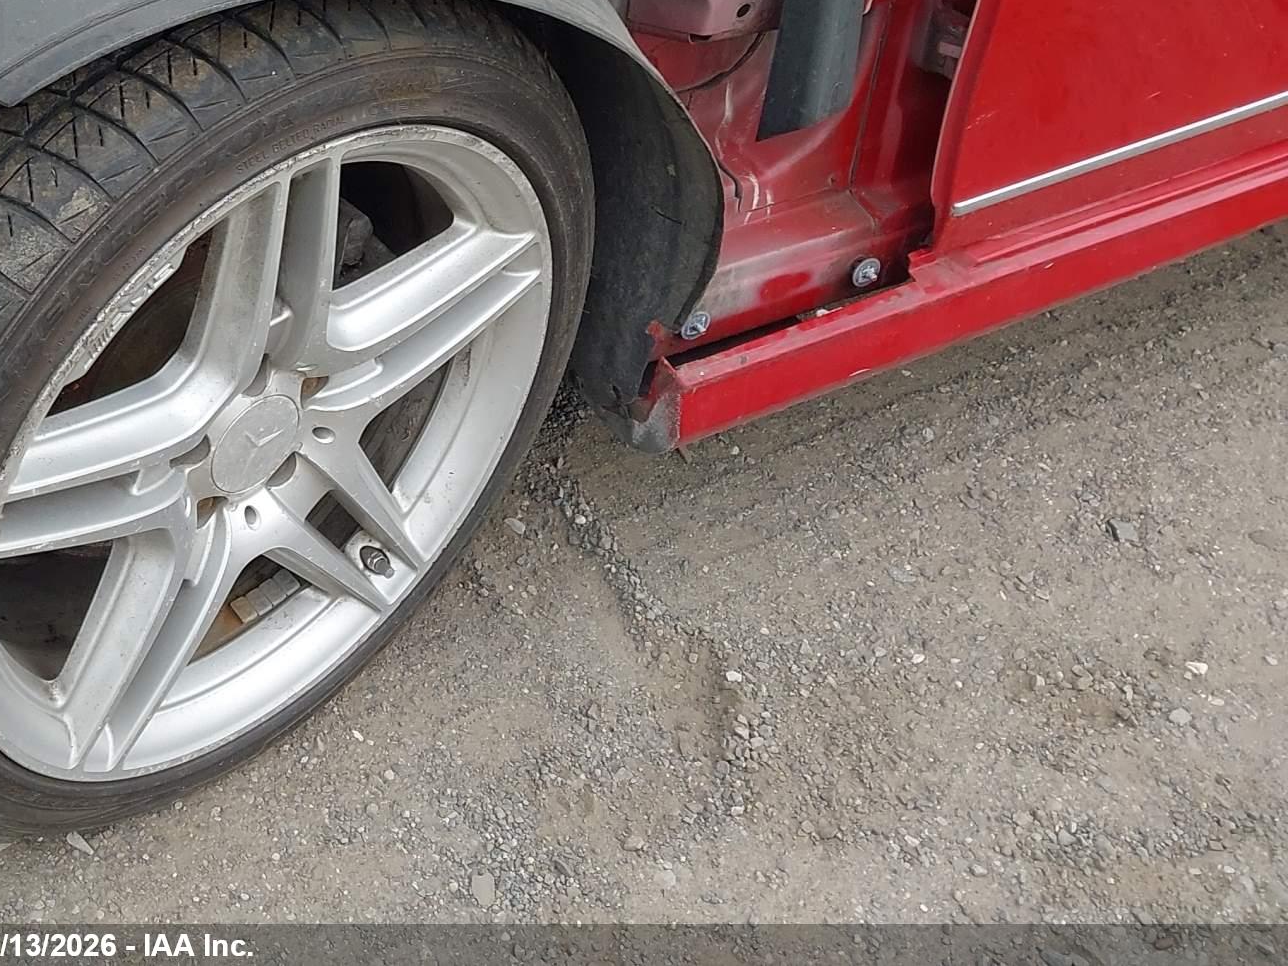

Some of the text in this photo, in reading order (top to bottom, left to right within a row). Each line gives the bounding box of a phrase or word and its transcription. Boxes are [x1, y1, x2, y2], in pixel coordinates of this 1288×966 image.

[235, 113, 347, 174] STEEL BELTED RADIAL
